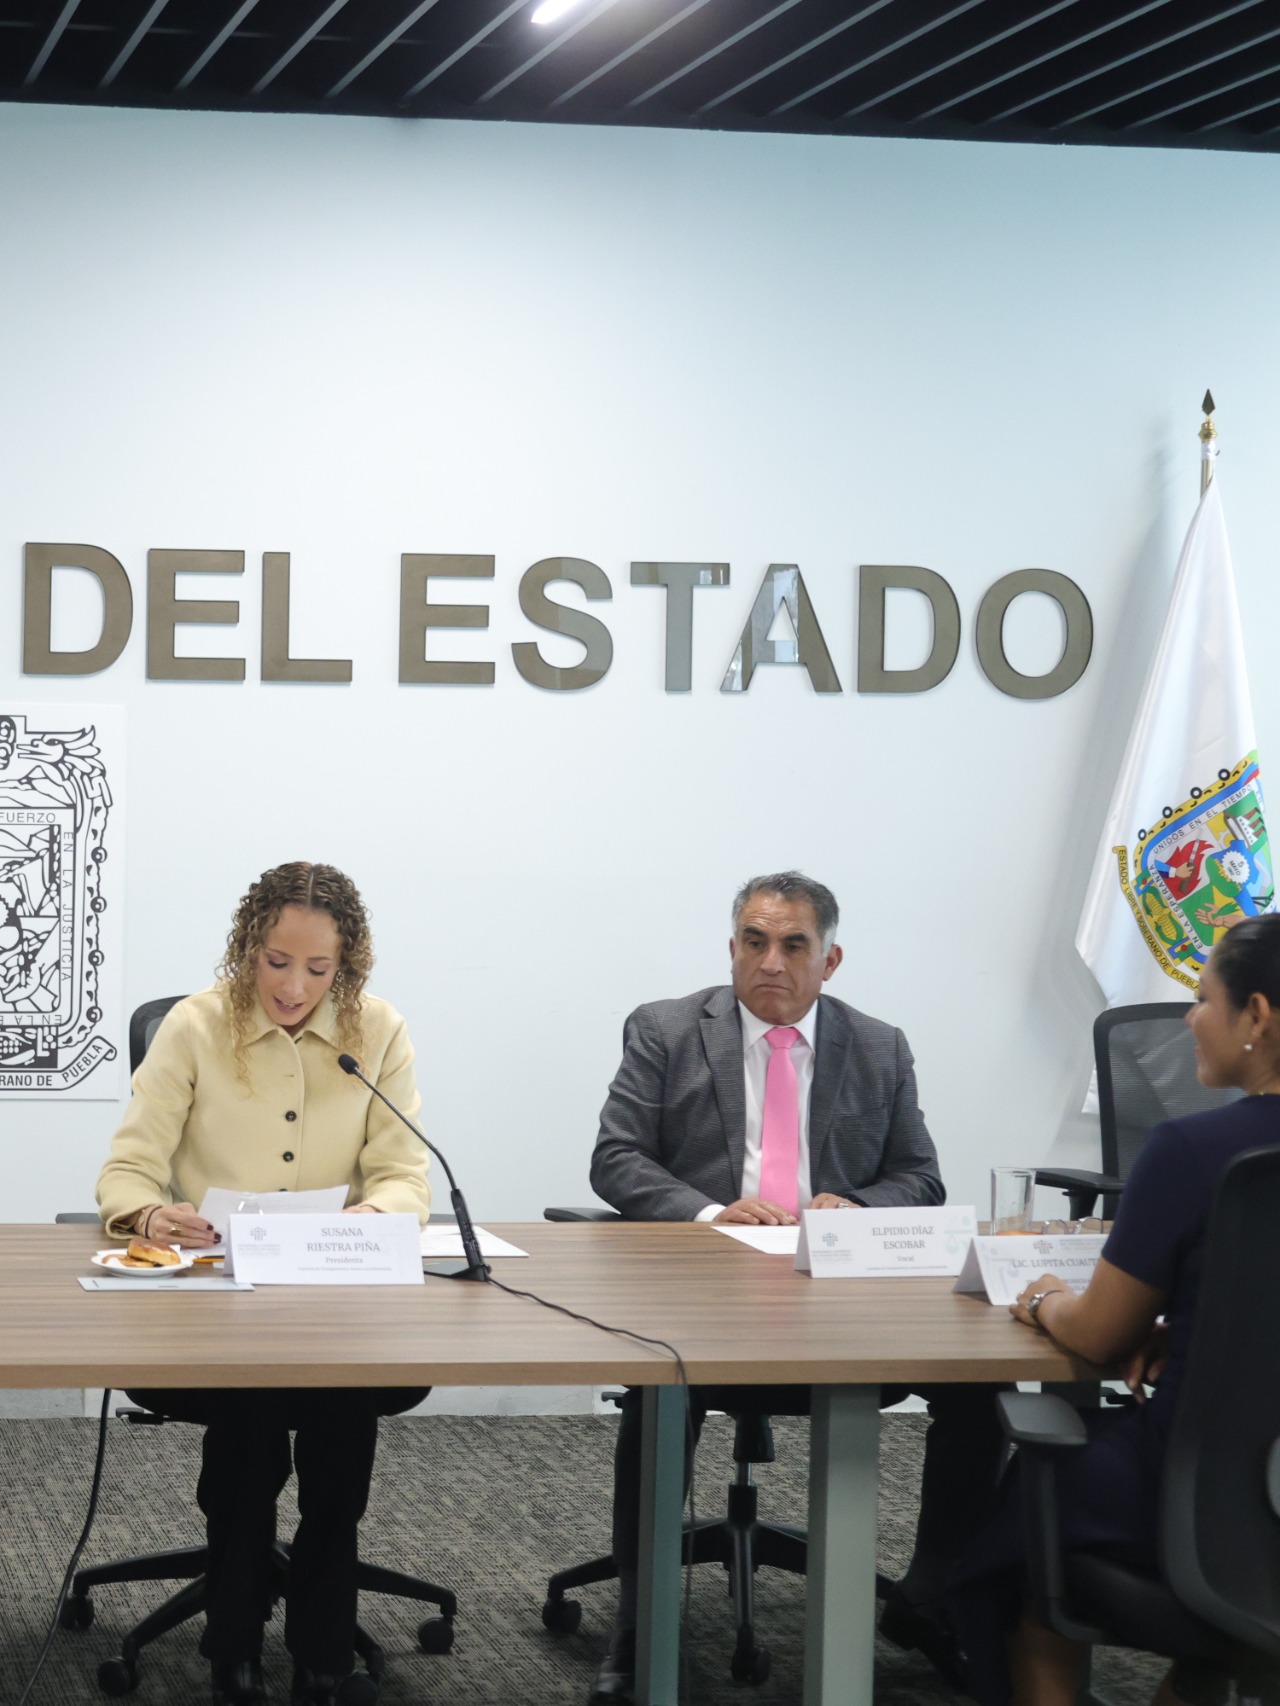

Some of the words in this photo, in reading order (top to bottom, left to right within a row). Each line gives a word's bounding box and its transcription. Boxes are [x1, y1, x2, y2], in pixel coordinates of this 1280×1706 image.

[22, 541, 354, 683] DEL
[397, 552, 1095, 700] ESTADO
[1153, 830, 1185, 854] UNIDOS
[1189, 818, 1202, 830] EN
[1205, 810, 1218, 819] EL
[1221, 784, 1252, 808] TIEMPO
[63, 831, 74, 853] EN
[1229, 860, 1241, 876] MAYO
[1237, 860, 1245, 868] 5
[62, 868, 73, 889] LA
[1150, 863, 1185, 919] ESPERANZA
[1118, 849, 1128, 885] ESTADO
[1137, 914, 1163, 957] SOBERANO
[1160, 957, 1171, 970] DE
[1184, 921, 1195, 935] LA
[61, 903, 73, 982] JUSTICIA
[1192, 936, 1203, 950] EN
[14, 1014, 34, 1025] LA
[42, 1014, 62, 1025] EN
[36, 1074, 53, 1086] DE
[61, 1043, 104, 1084] PUEBLA
[321, 1227, 363, 1237] SUSANA
[872, 1227, 910, 1236] ELPIDIO
[912, 1225, 934, 1236] DÍAZ
[307, 1242, 352, 1252] RIESTRA
[354, 1240, 380, 1252] PIÑA
[883, 1240, 926, 1250] ESCOBAR
[1013, 1259, 1032, 1268] LIC.
[1033, 1259, 1065, 1268] LUPITA
[1066, 1258, 1096, 1267] CUAUT
